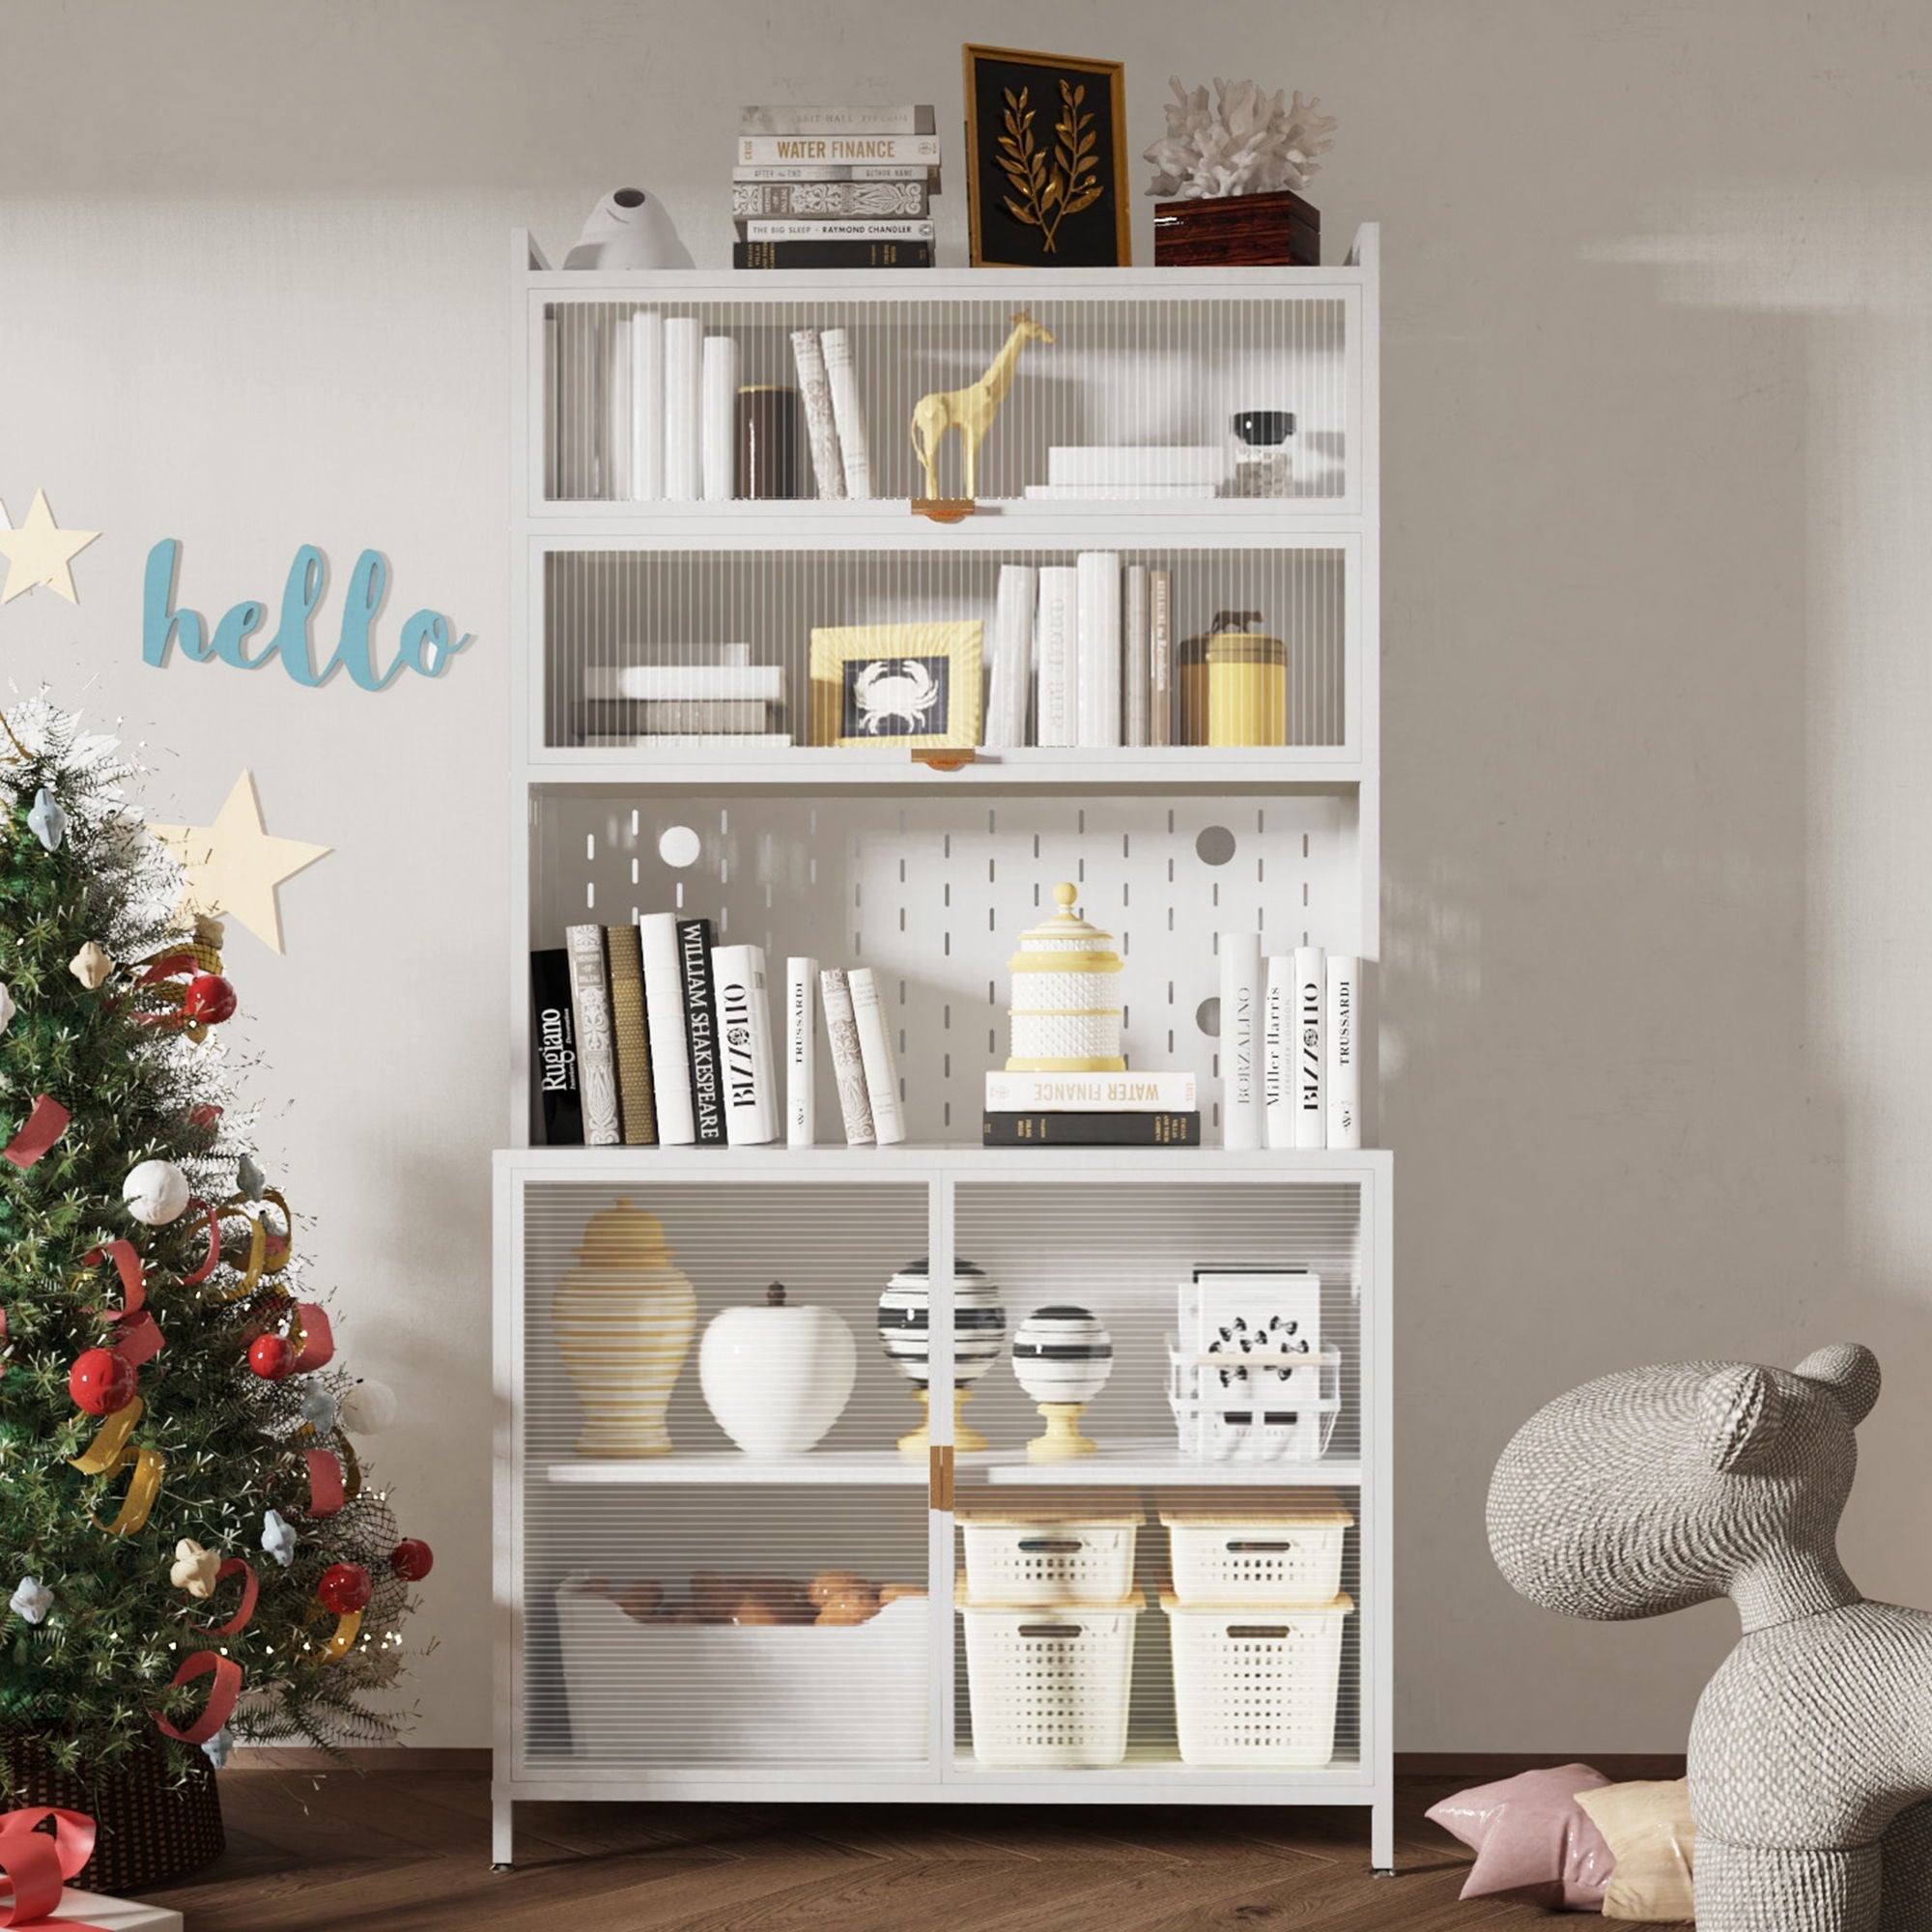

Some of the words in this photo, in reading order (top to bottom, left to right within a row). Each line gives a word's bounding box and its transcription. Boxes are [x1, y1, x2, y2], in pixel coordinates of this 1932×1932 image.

[777, 141, 826, 158] WATER
[832, 140, 895, 158] FINANCE
[143, 538, 470, 692] hello
[683, 923, 708, 1009] WILLIAM
[538, 1008, 576, 1091] Rugiano
[795, 982, 804, 1065] TRUSSARDI
[1237, 987, 1251, 1103] BORZALINO
[1267, 987, 1279, 1045] Harris
[1340, 981, 1350, 1065] TRUSSARDI
[691, 1012, 719, 1139] SHAKESPEARE
[1035, 1083, 1101, 1101] FINANCE
[1108, 1083, 1159, 1100] WATER
[1267, 1051, 1279, 1106] Miller
